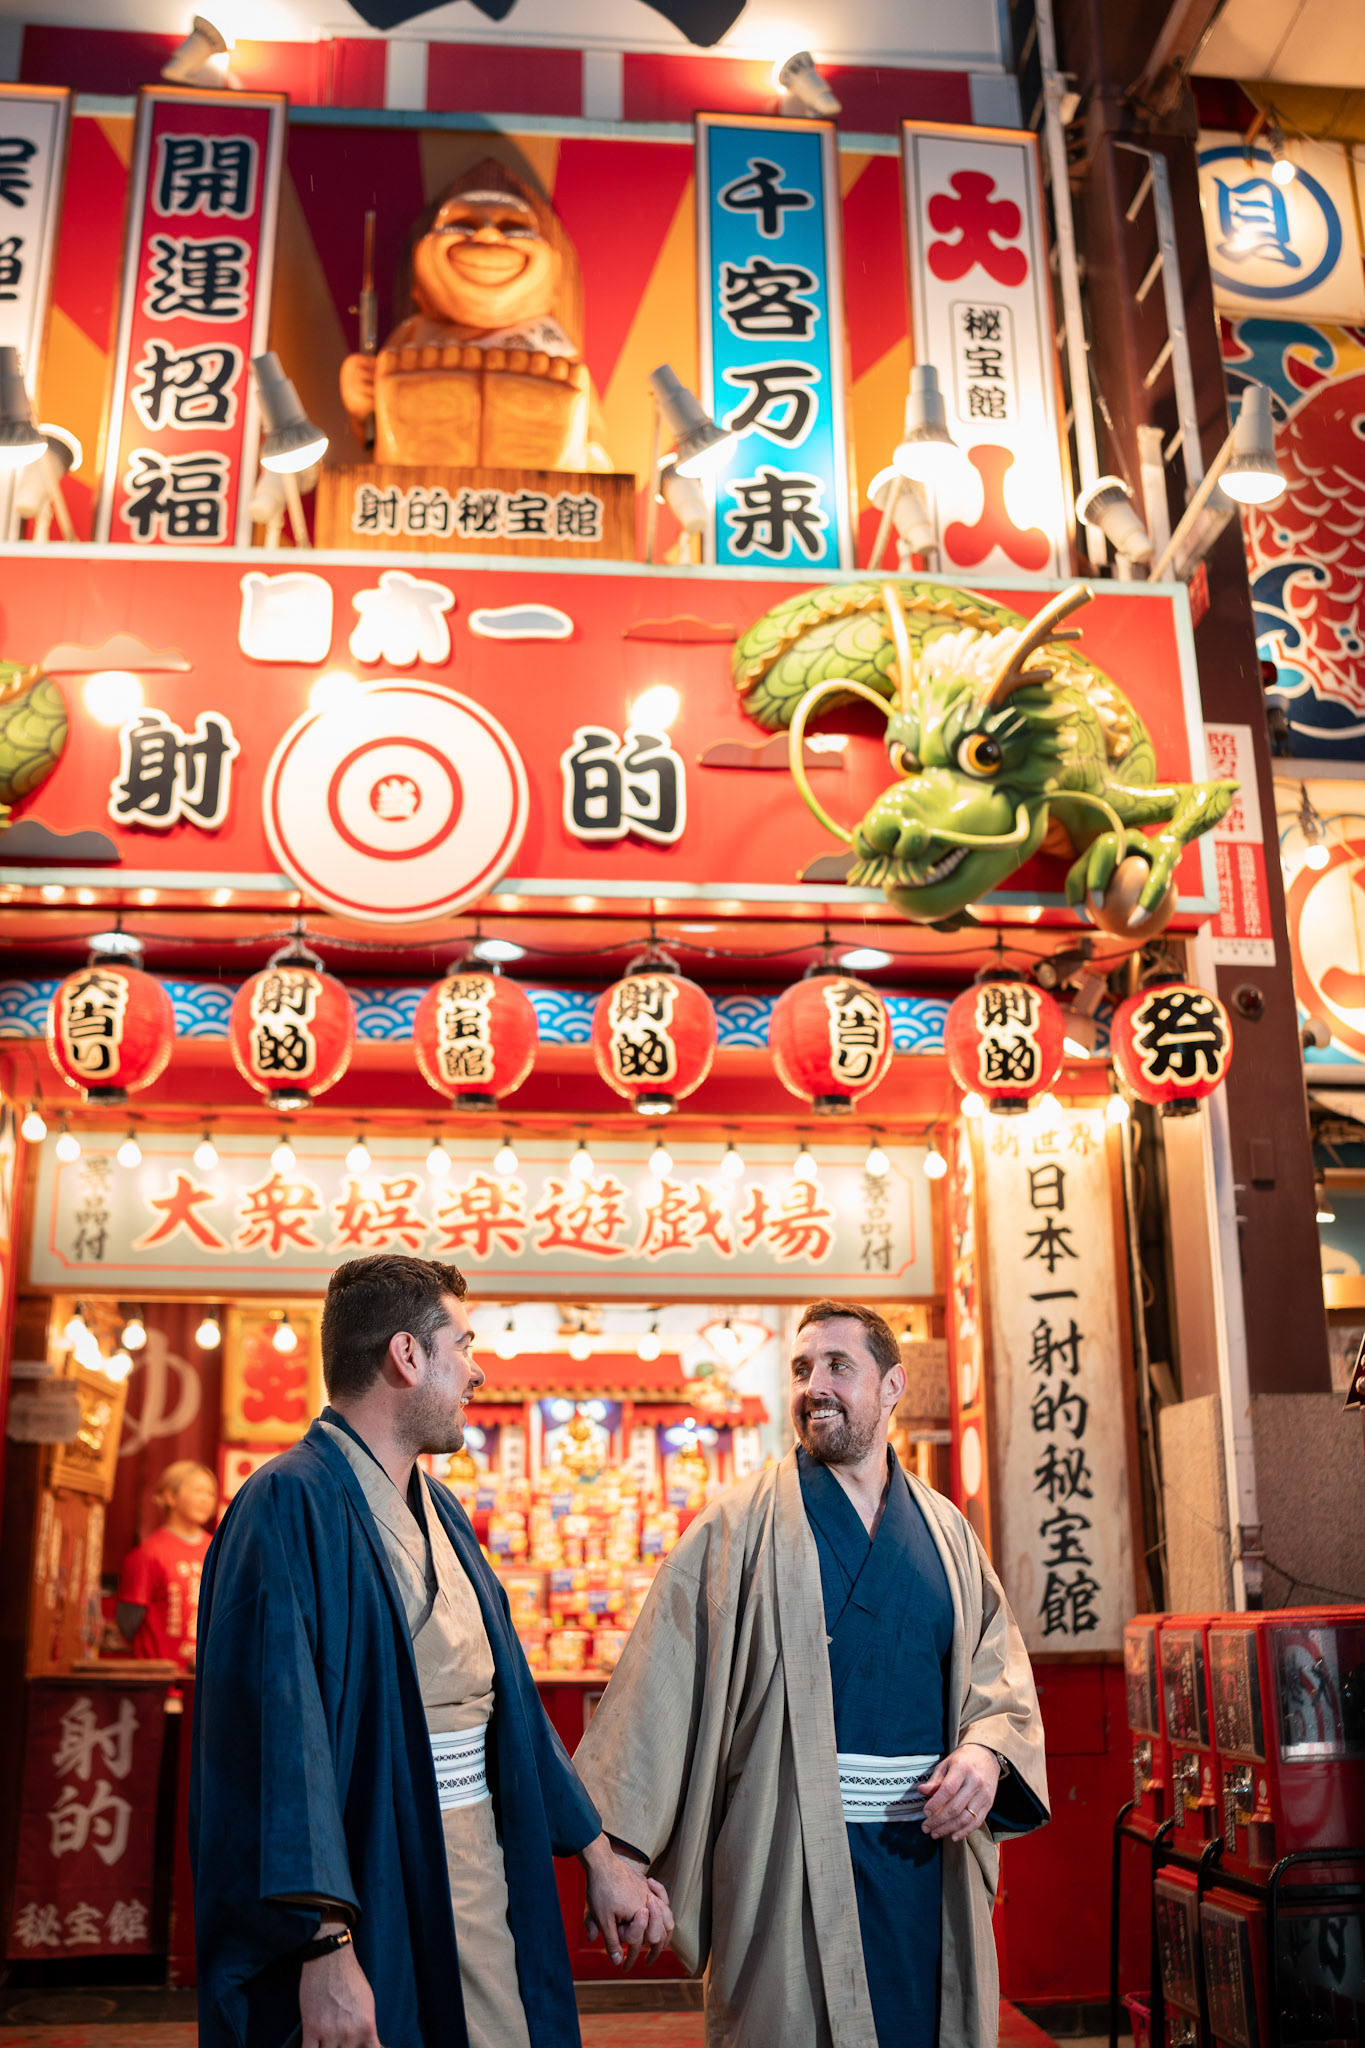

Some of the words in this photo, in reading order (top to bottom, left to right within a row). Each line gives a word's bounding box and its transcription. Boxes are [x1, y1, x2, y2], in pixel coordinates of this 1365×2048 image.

[124, 135, 256, 541] 開運招福
[720, 159, 828, 560] 千客万来
[963, 307, 1007, 419] 秘宝館
[355, 486, 603, 540] 射的秘宝館
[65, 972, 123, 1074] 大当り
[256, 973, 317, 1073] 射的
[443, 979, 488, 1078] 秘宝館
[616, 979, 672, 1077] 射的
[833, 982, 881, 1080] 大当り
[984, 985, 1037, 1082] 射的
[1134, 993, 1227, 1080] 祭
[138, 1171, 832, 1260] 大衆娯楽遊戯場
[1022, 1162, 1102, 1637] 日本一射的秘宝館
[47, 1696, 139, 1867] 射的
[15, 1899, 150, 1948] 秘宝館
